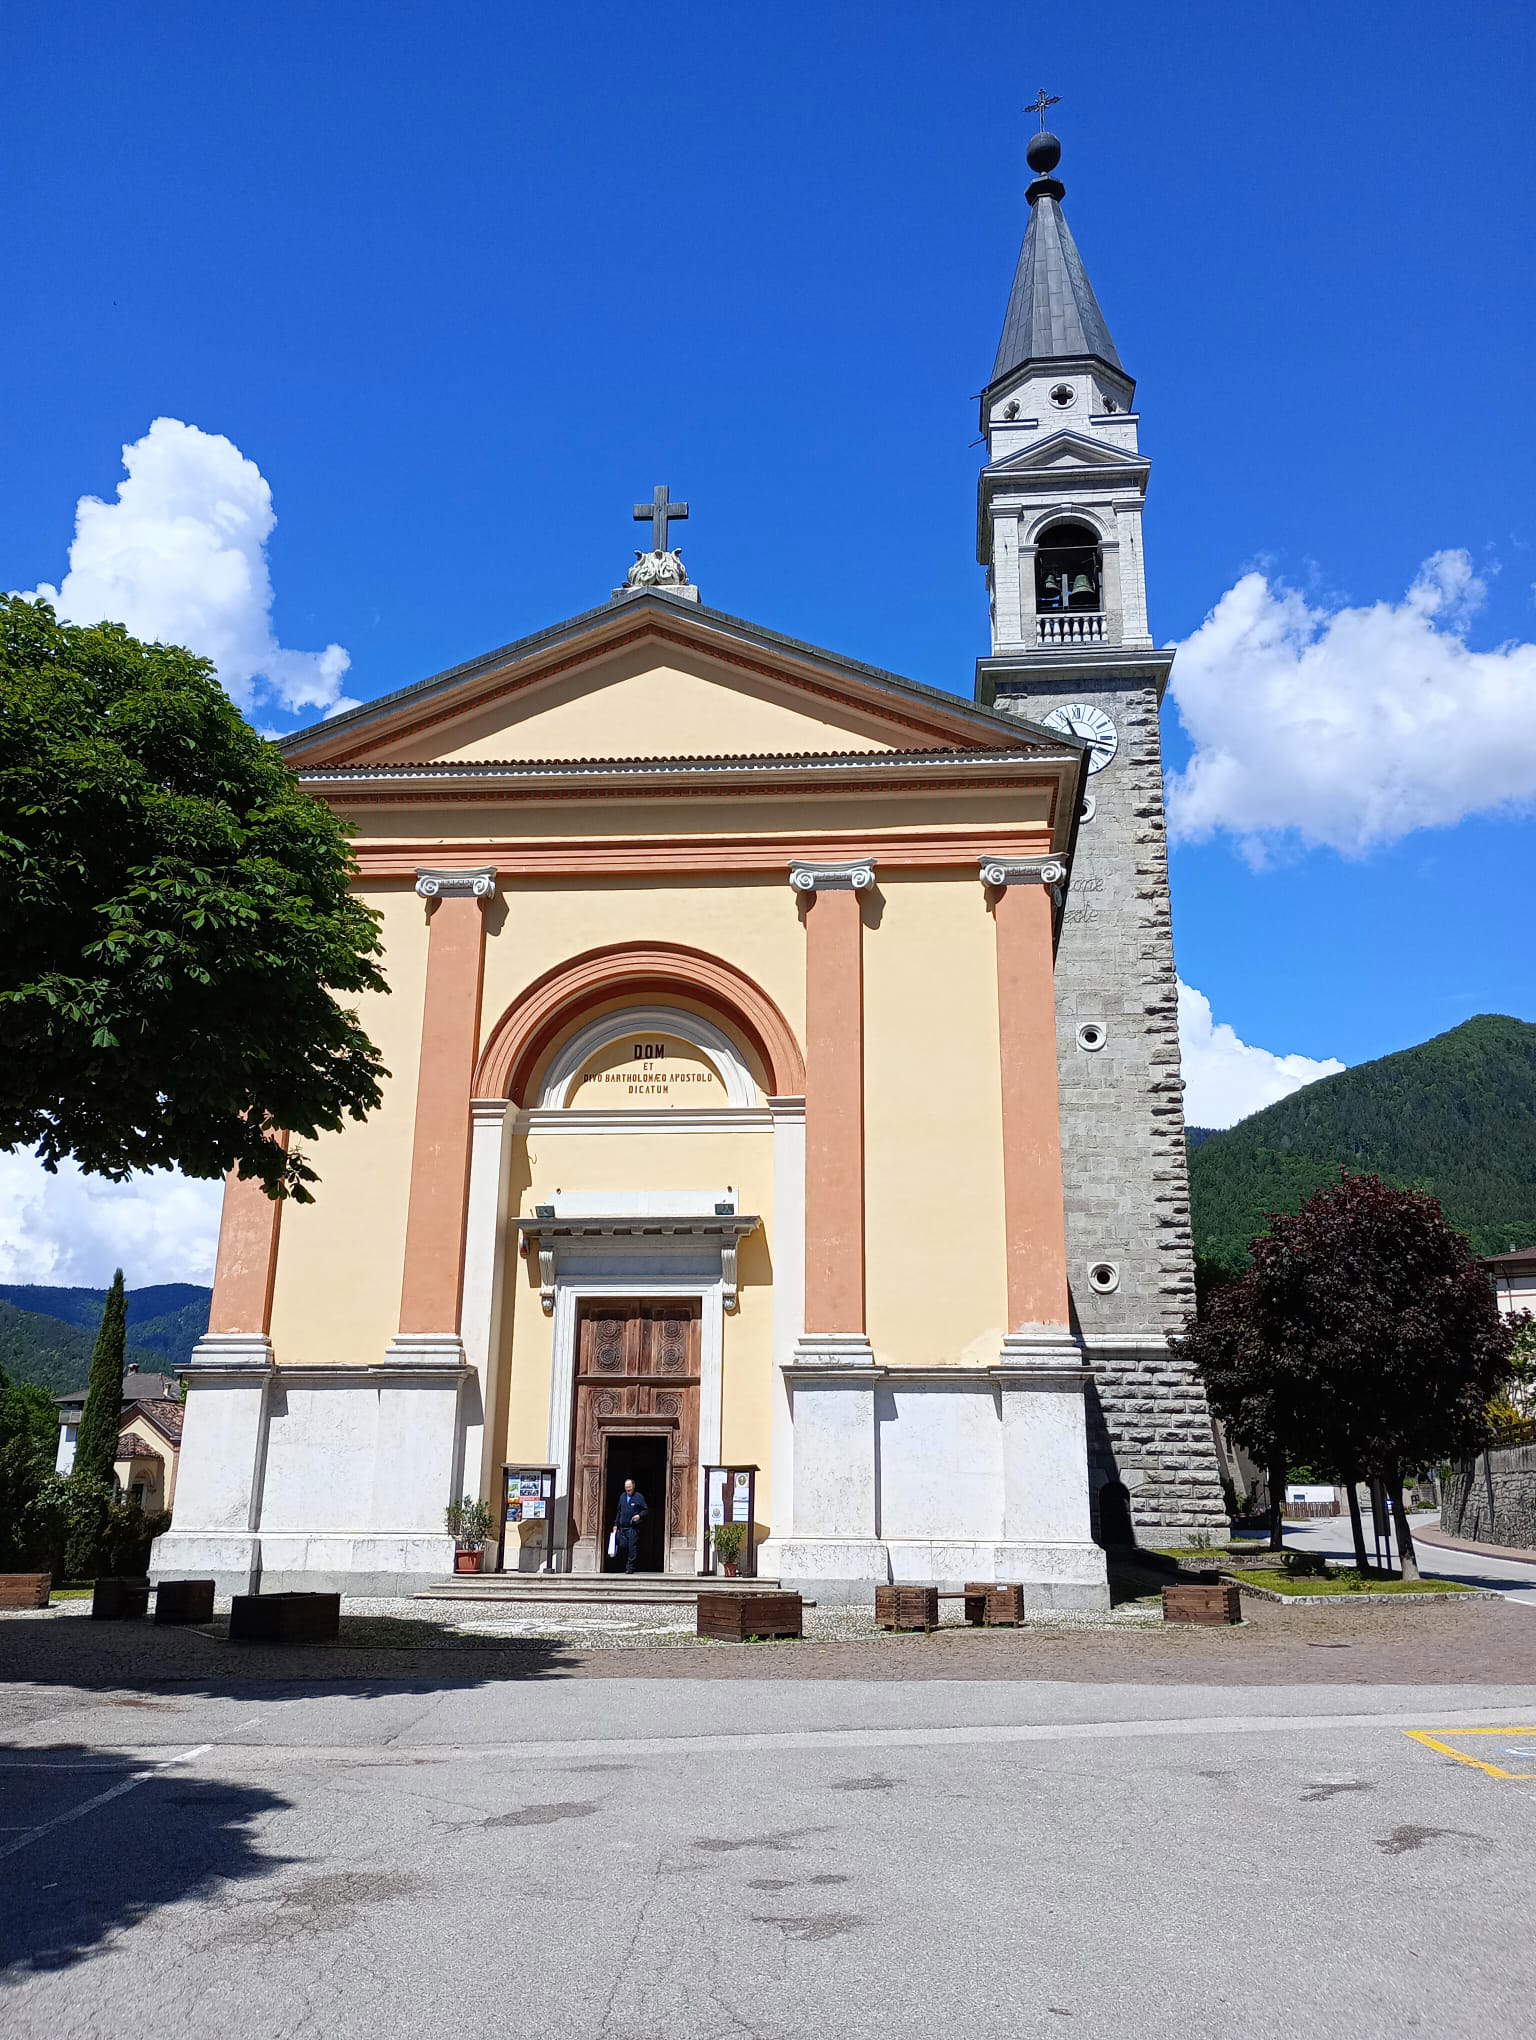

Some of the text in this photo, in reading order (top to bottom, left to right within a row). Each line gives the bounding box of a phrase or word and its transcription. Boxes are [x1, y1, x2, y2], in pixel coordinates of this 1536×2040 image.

[634, 1044, 665, 1060] DOM
[643, 1062, 654, 1071] ET
[583, 1073, 603, 1083] DIVO
[669, 1072, 713, 1082] APOSTOLO
[628, 1085, 669, 1094] DICATUM
